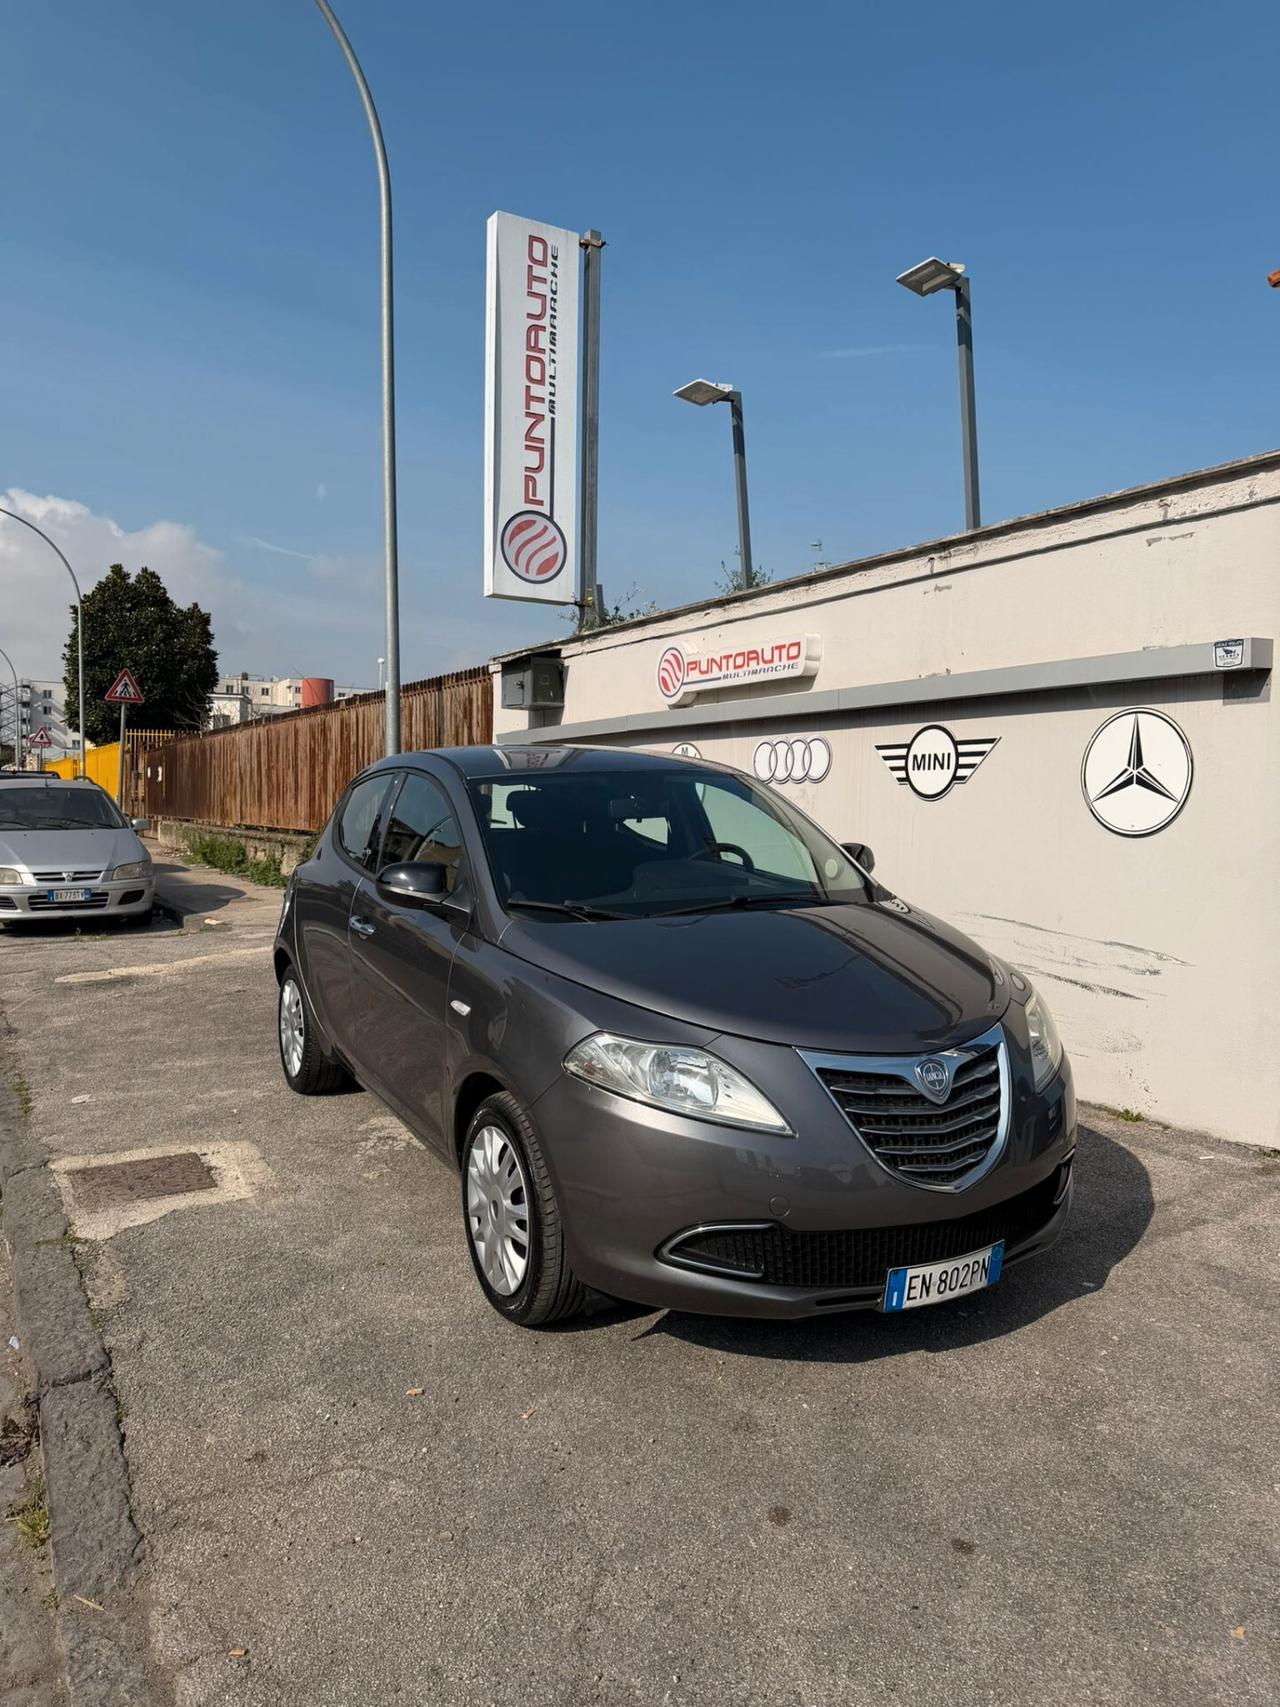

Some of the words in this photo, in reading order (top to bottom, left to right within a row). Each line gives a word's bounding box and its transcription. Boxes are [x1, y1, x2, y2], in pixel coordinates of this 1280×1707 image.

[548, 243, 559, 415] MULTIMARCHE
[524, 234, 549, 507] PUNTOAUTO
[686, 641, 801, 678] PUNTOAUTO
[912, 752, 951, 771] MINI
[906, 1273, 933, 1301] EN
[937, 1255, 991, 1295] 802PN
